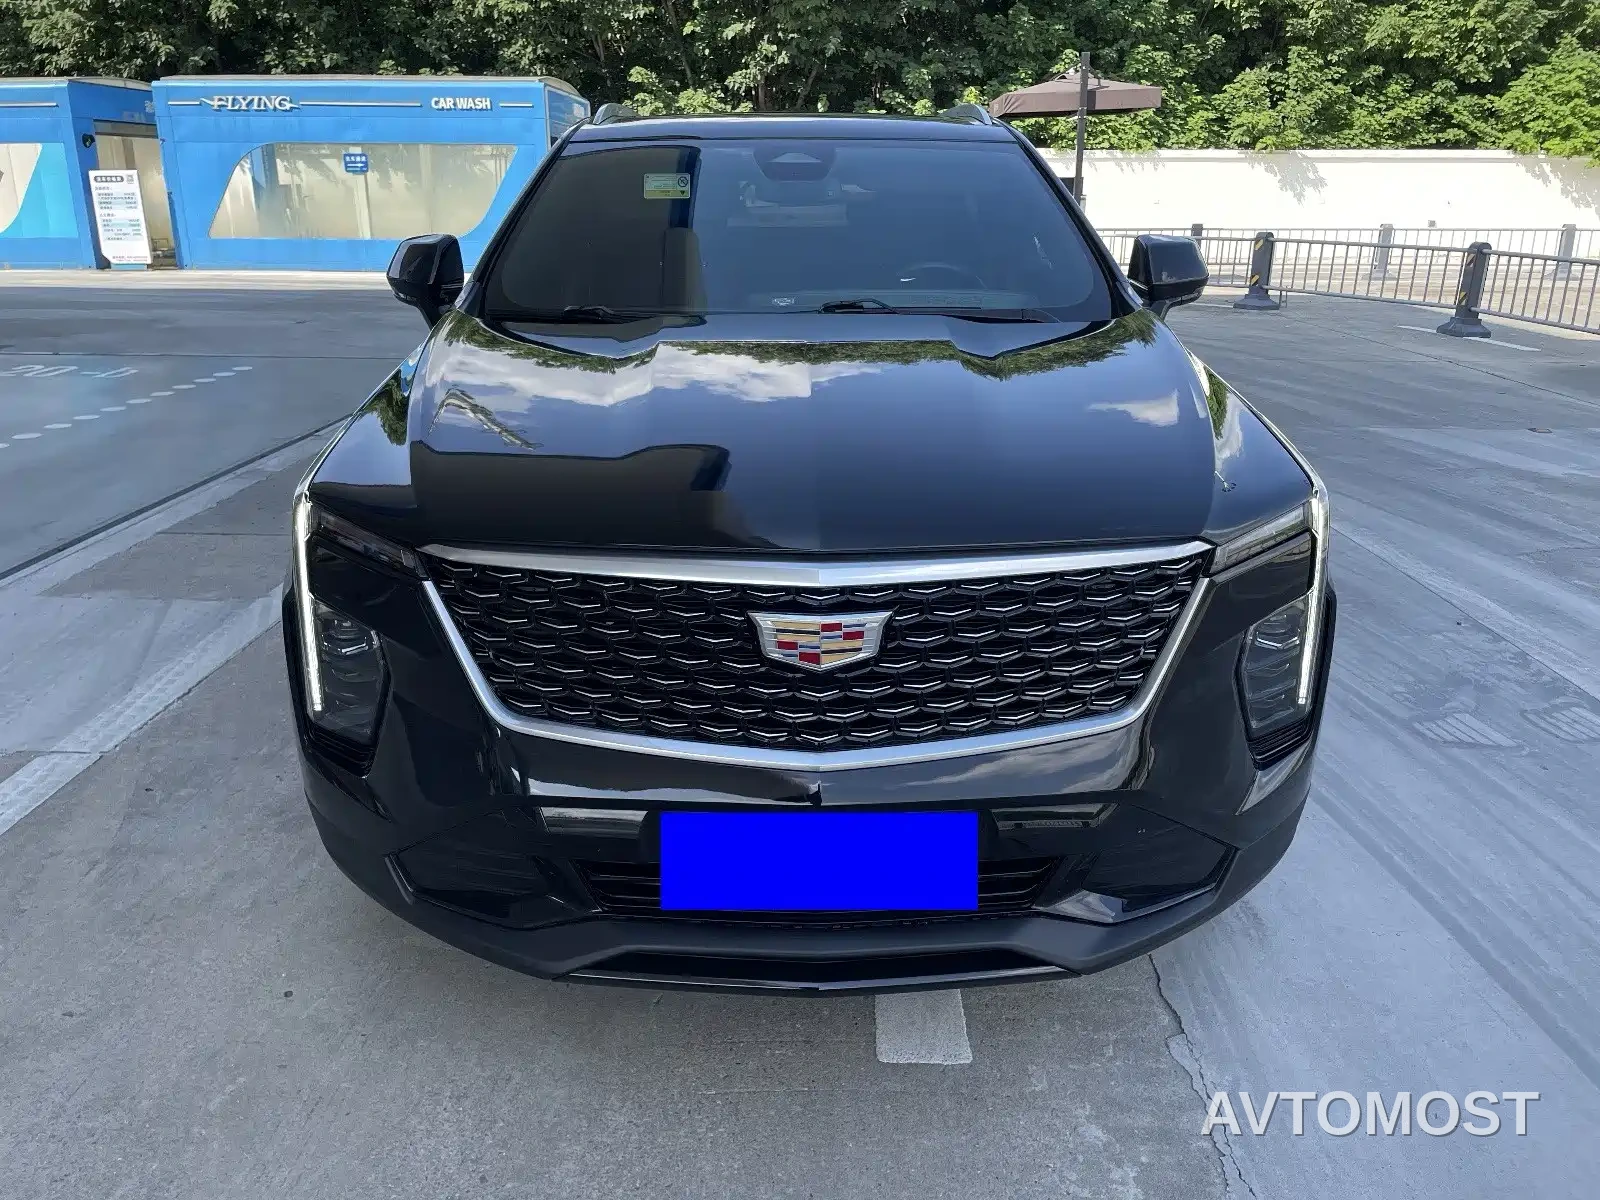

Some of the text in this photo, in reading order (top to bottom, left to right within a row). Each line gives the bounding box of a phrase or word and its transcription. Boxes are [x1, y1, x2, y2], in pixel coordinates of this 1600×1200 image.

[212, 95, 293, 111] FLYING
[431, 97, 492, 110] CAR WASH
